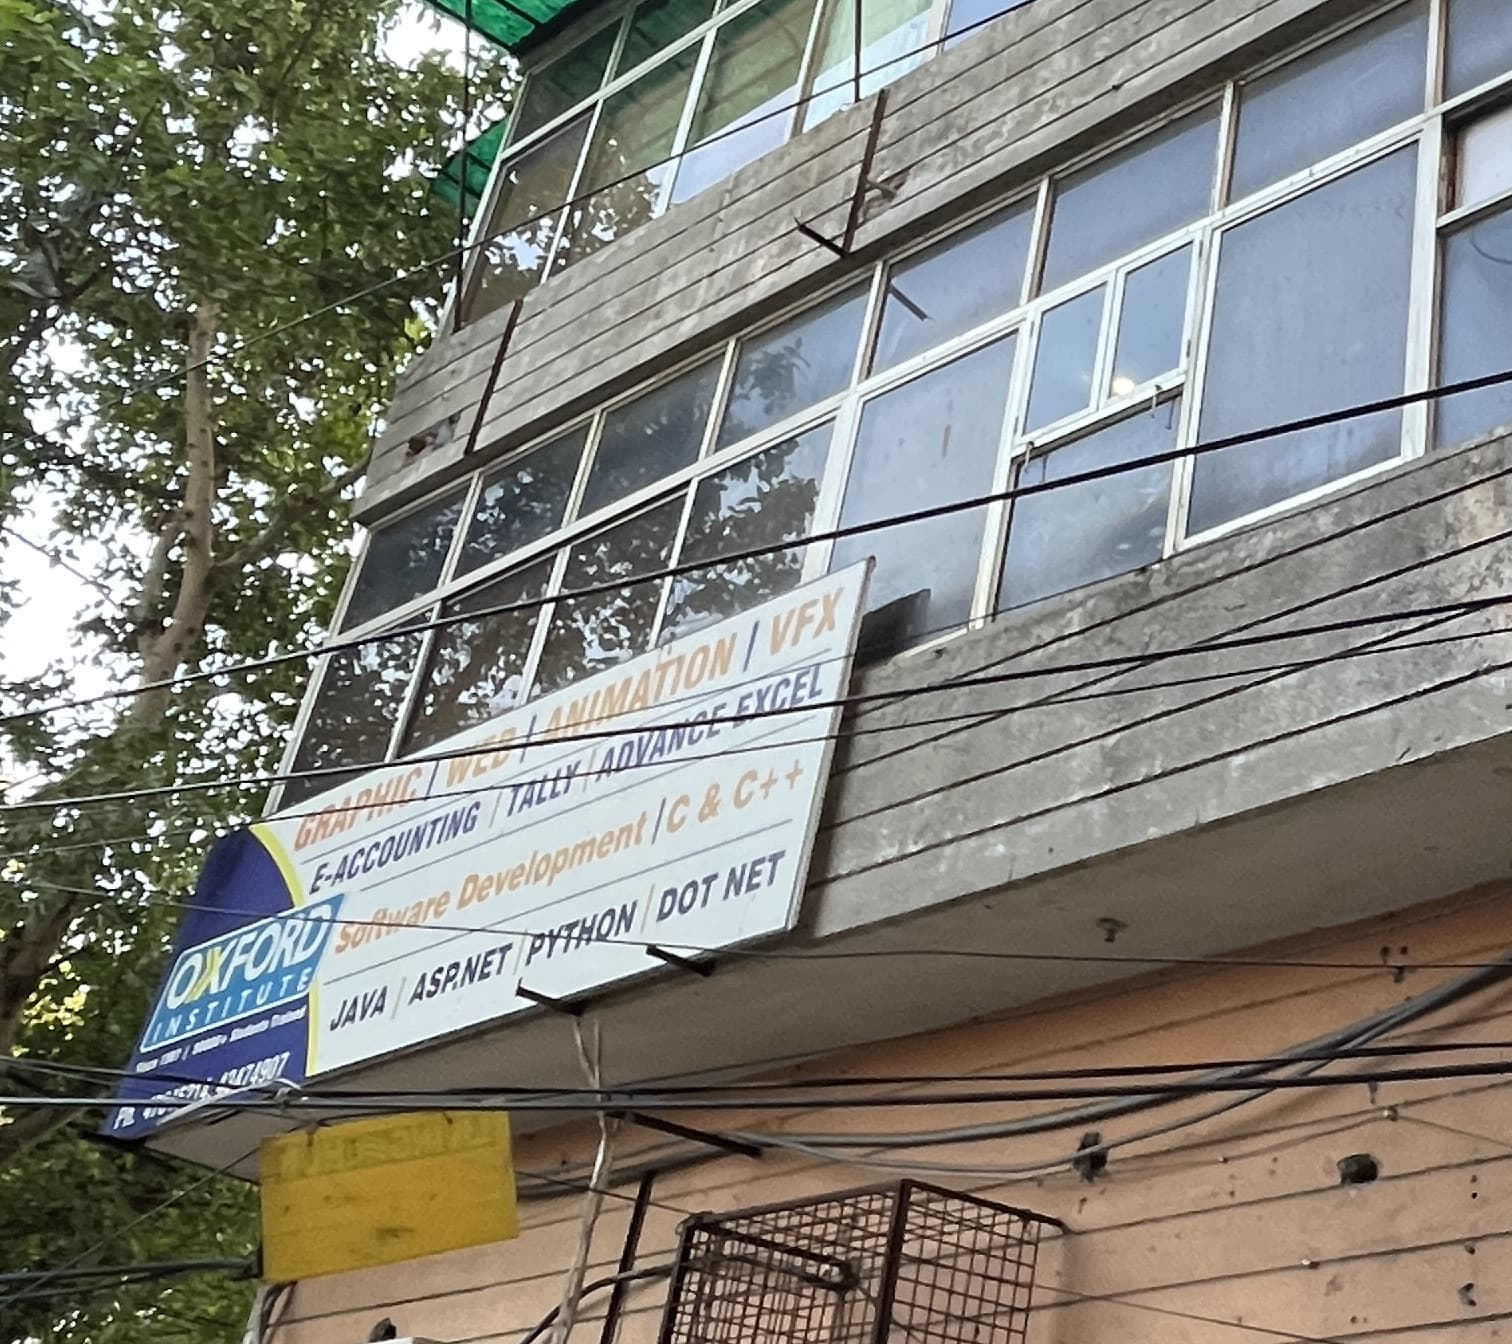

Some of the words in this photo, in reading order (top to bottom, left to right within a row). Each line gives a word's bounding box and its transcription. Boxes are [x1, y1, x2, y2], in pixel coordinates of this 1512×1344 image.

[294, 766, 423, 851] GRAPHIC
[447, 727, 517, 788] WEB
[543, 632, 738, 740] ANIMATION
[769, 587, 844, 655] VFX
[309, 801, 481, 895] E-ACCOUNTING
[506, 760, 583, 817] TALLY
[595, 702, 729, 782] ADVANCE
[732, 664, 823, 730] EXCEL
[167, 904, 332, 1009] OXFORD
[330, 985, 388, 1031] JAVA
[408, 943, 513, 1006] ASP.NET
[525, 899, 638, 966] PYTHON
[656, 873, 719, 923] DOT
[722, 850, 786, 901] NET
[335, 890, 451, 954] Software
[457, 811, 648, 910] Development
[666, 795, 690, 833] C
[698, 783, 721, 824] &
[153, 967, 314, 1042] INSTITUTE
